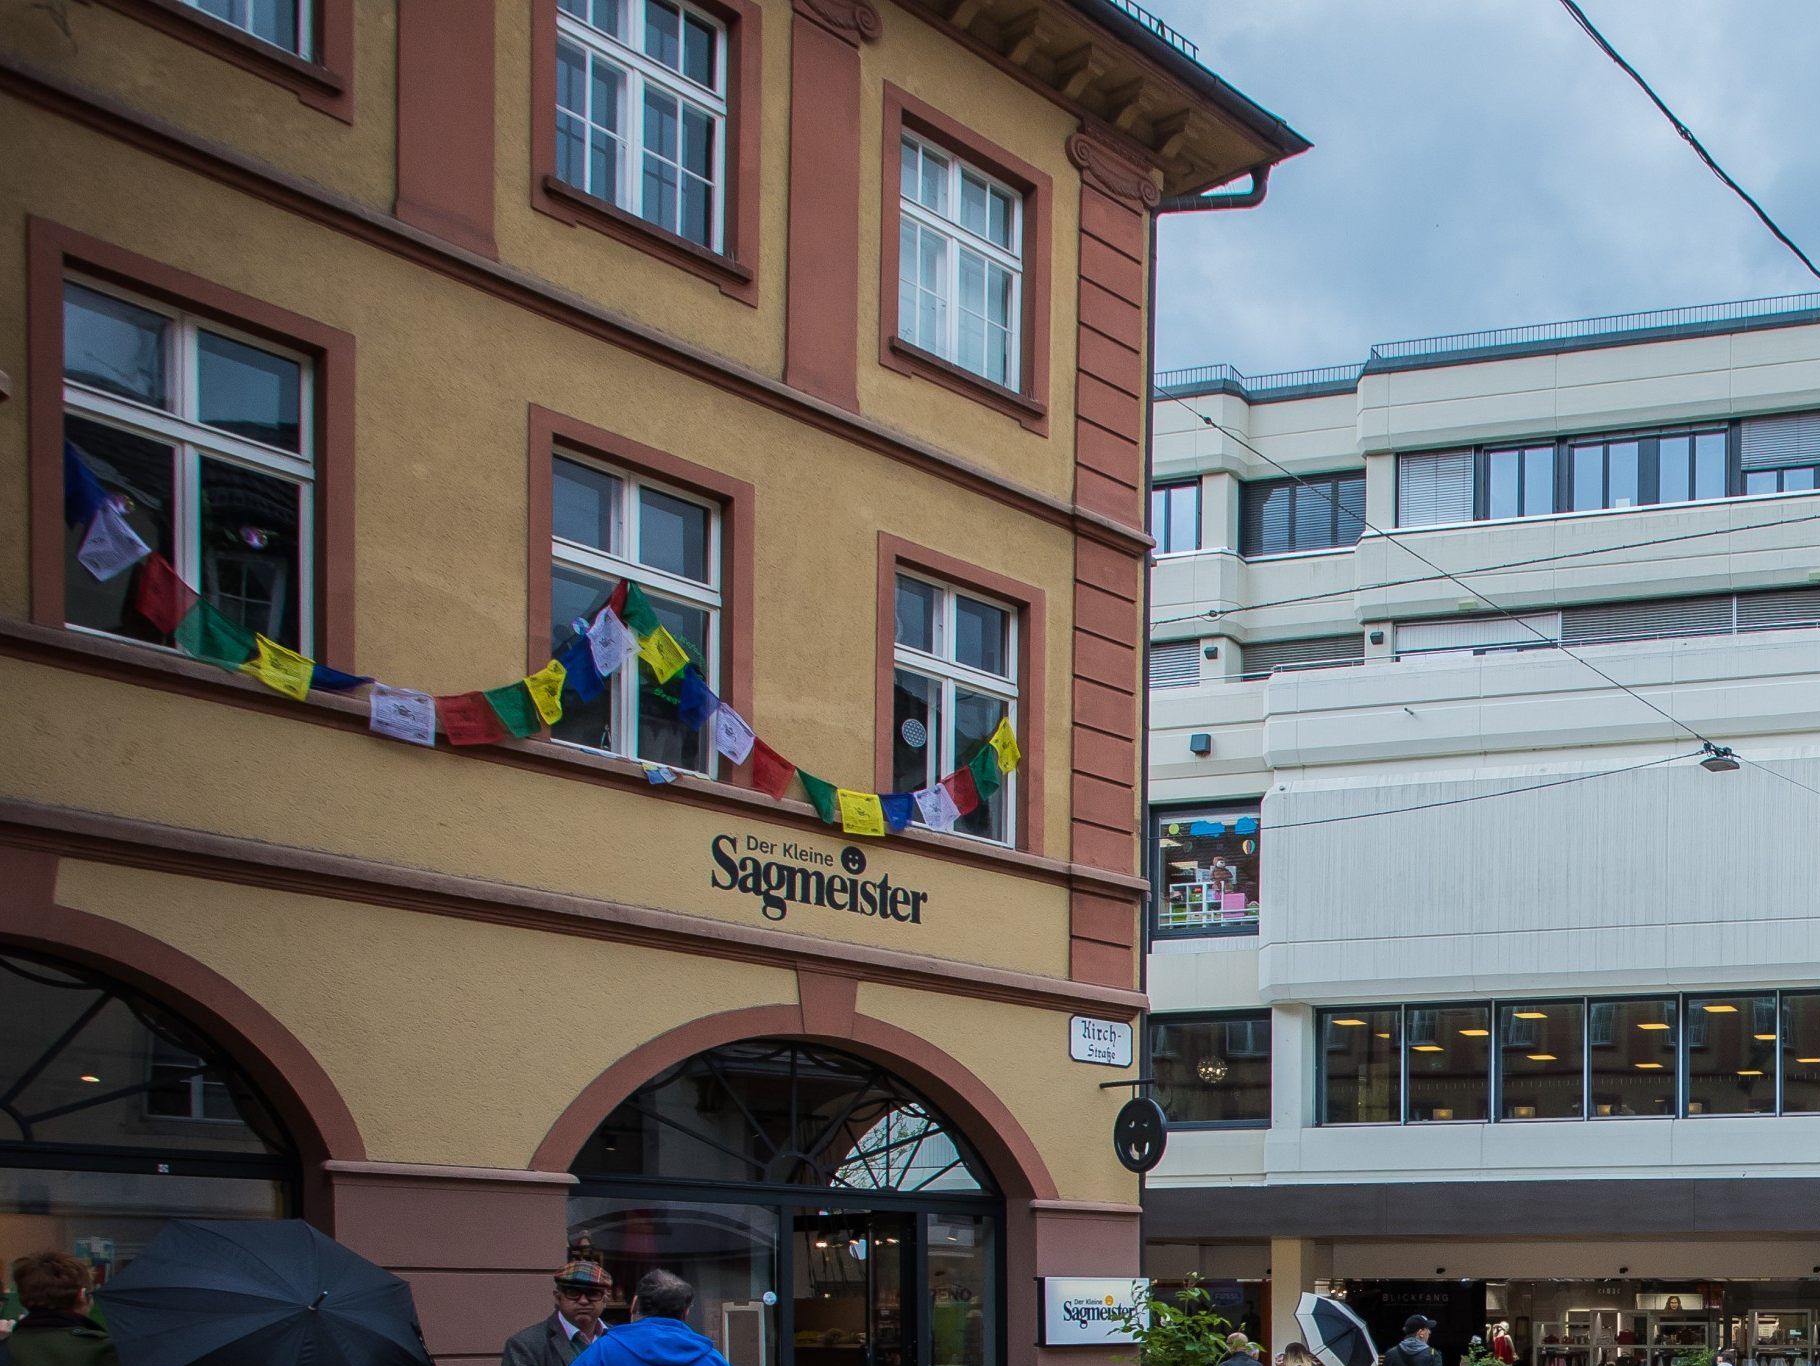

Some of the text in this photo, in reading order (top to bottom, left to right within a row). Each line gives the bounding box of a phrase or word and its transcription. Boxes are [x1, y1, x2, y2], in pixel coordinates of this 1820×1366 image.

[711, 834, 928, 924] Sagmeister
[746, 835, 834, 867] Der Kleine
